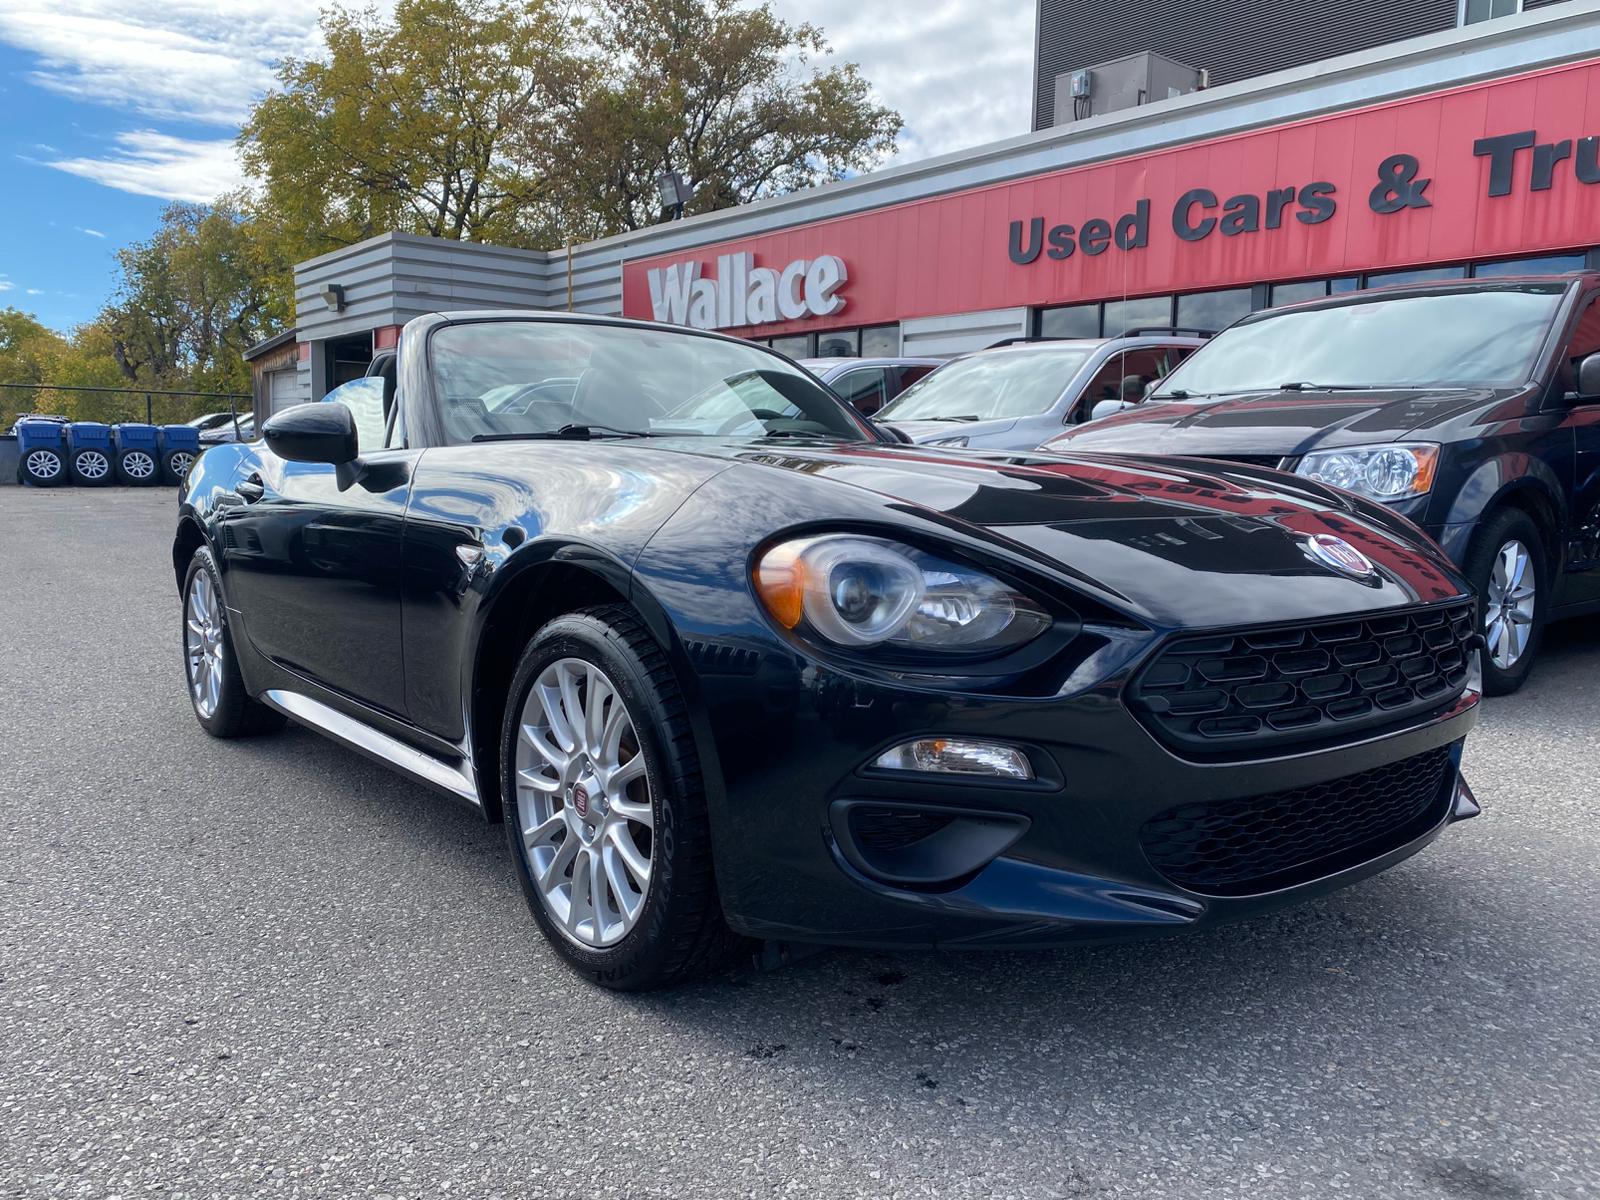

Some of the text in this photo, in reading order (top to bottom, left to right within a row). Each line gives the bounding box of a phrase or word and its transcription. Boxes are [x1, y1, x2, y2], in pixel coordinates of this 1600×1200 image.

[1008, 198, 1151, 265] Used
[1171, 180, 1337, 242] Cars
[1367, 153, 1432, 215] &
[647, 251, 848, 330] Wallace
[592, 798, 675, 983] CONTINNTAL
